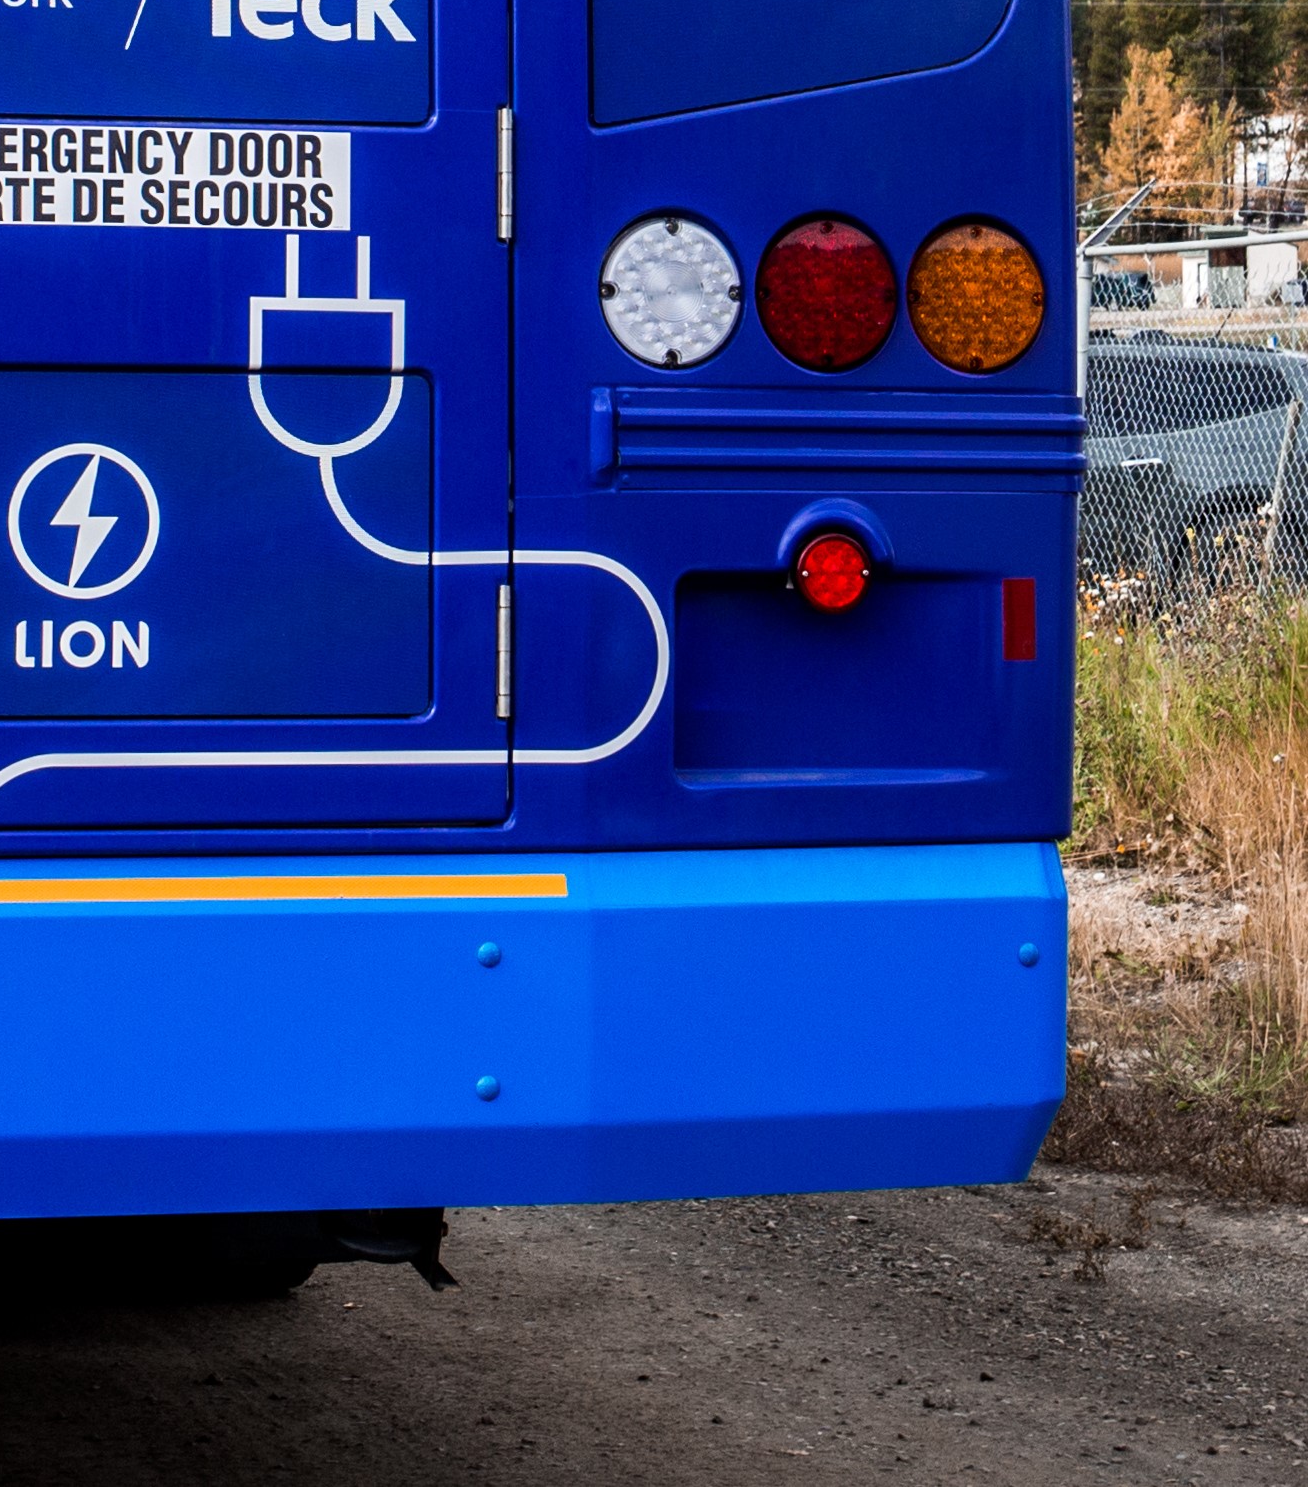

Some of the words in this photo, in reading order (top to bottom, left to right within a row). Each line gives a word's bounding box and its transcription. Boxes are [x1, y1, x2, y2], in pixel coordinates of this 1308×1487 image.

[209, 131, 323, 179] DOOR
[72, 178, 125, 224] DE
[140, 178, 334, 229] SECOURS
[15, 620, 150, 669] LION
